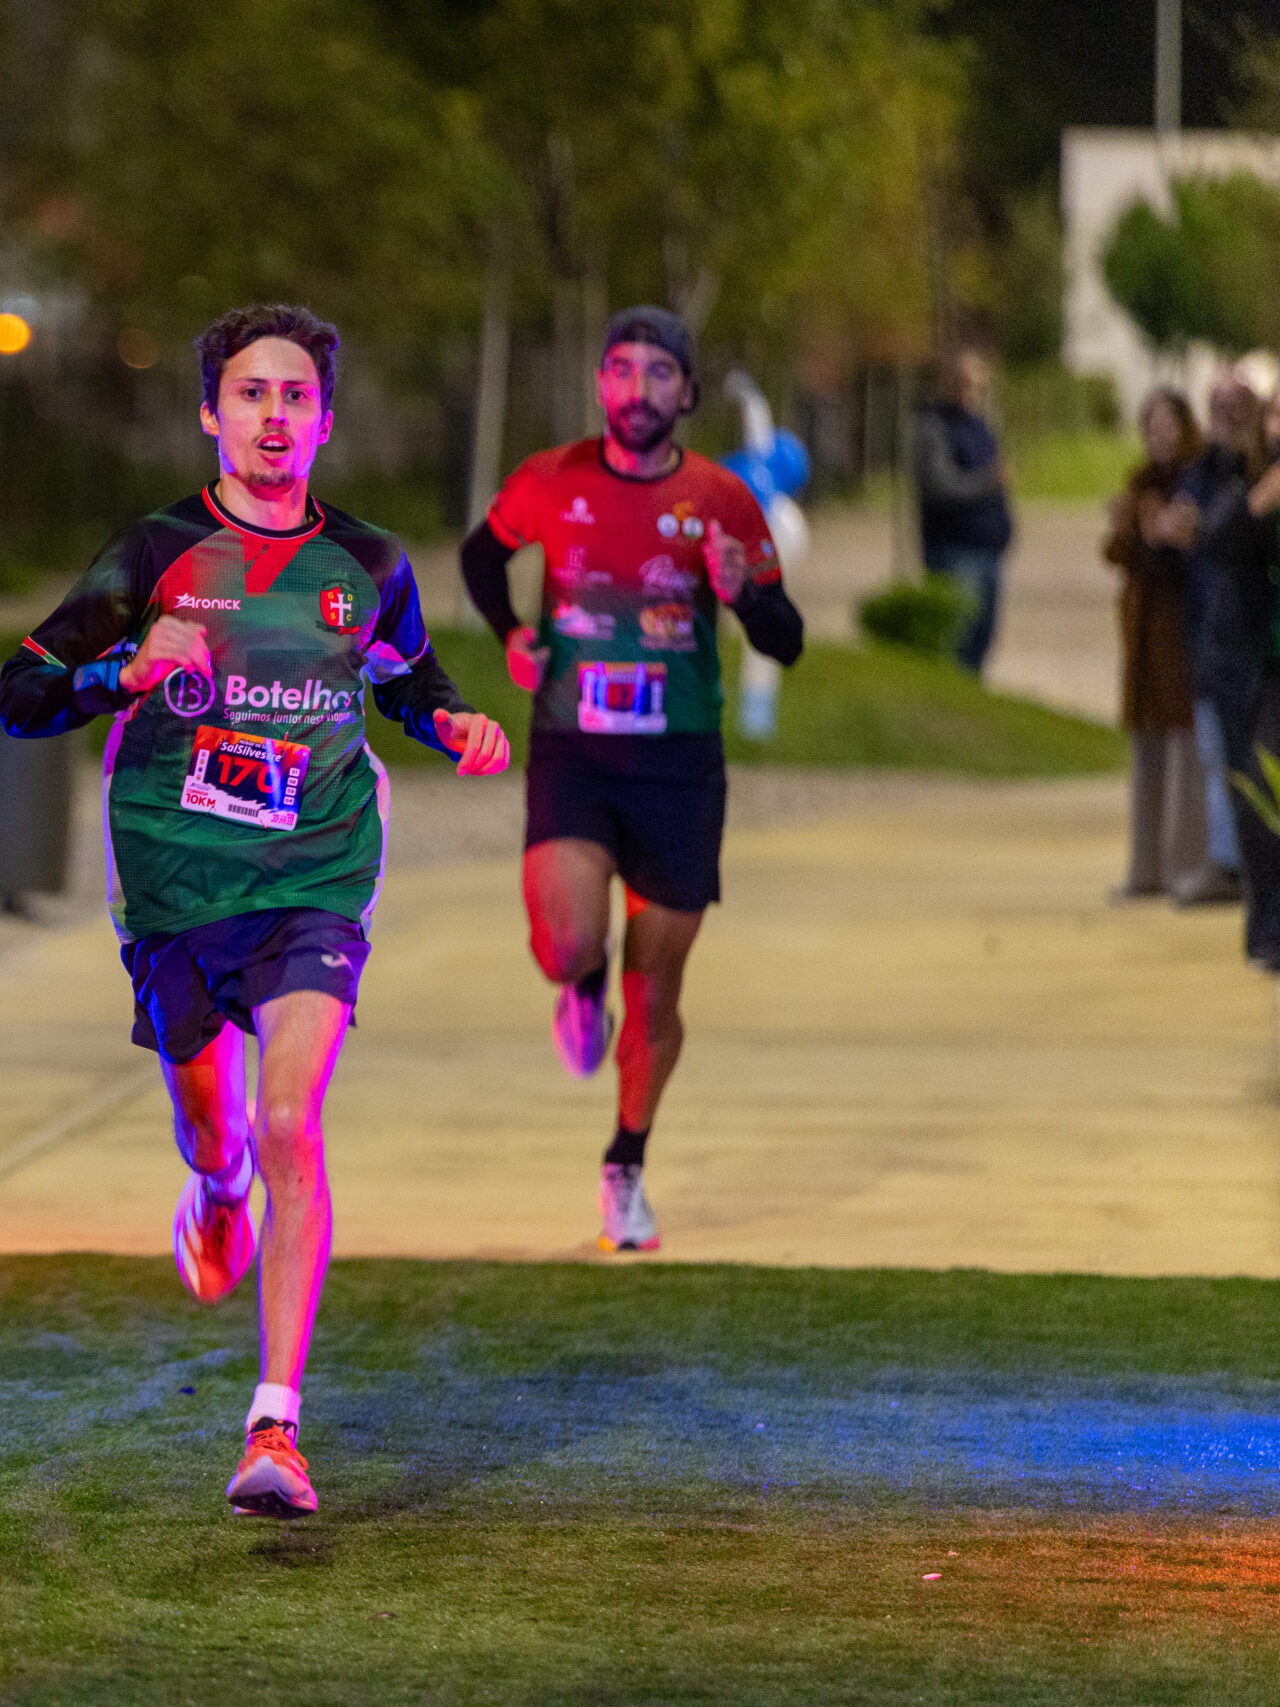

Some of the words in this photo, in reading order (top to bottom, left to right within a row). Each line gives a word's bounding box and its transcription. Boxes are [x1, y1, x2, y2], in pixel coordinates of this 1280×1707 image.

[223, 708, 271, 723] Seguimos
[273, 712, 303, 725] juntos
[220, 742, 282, 762] SalSilvestre
[186, 793, 216, 808] 10KM
